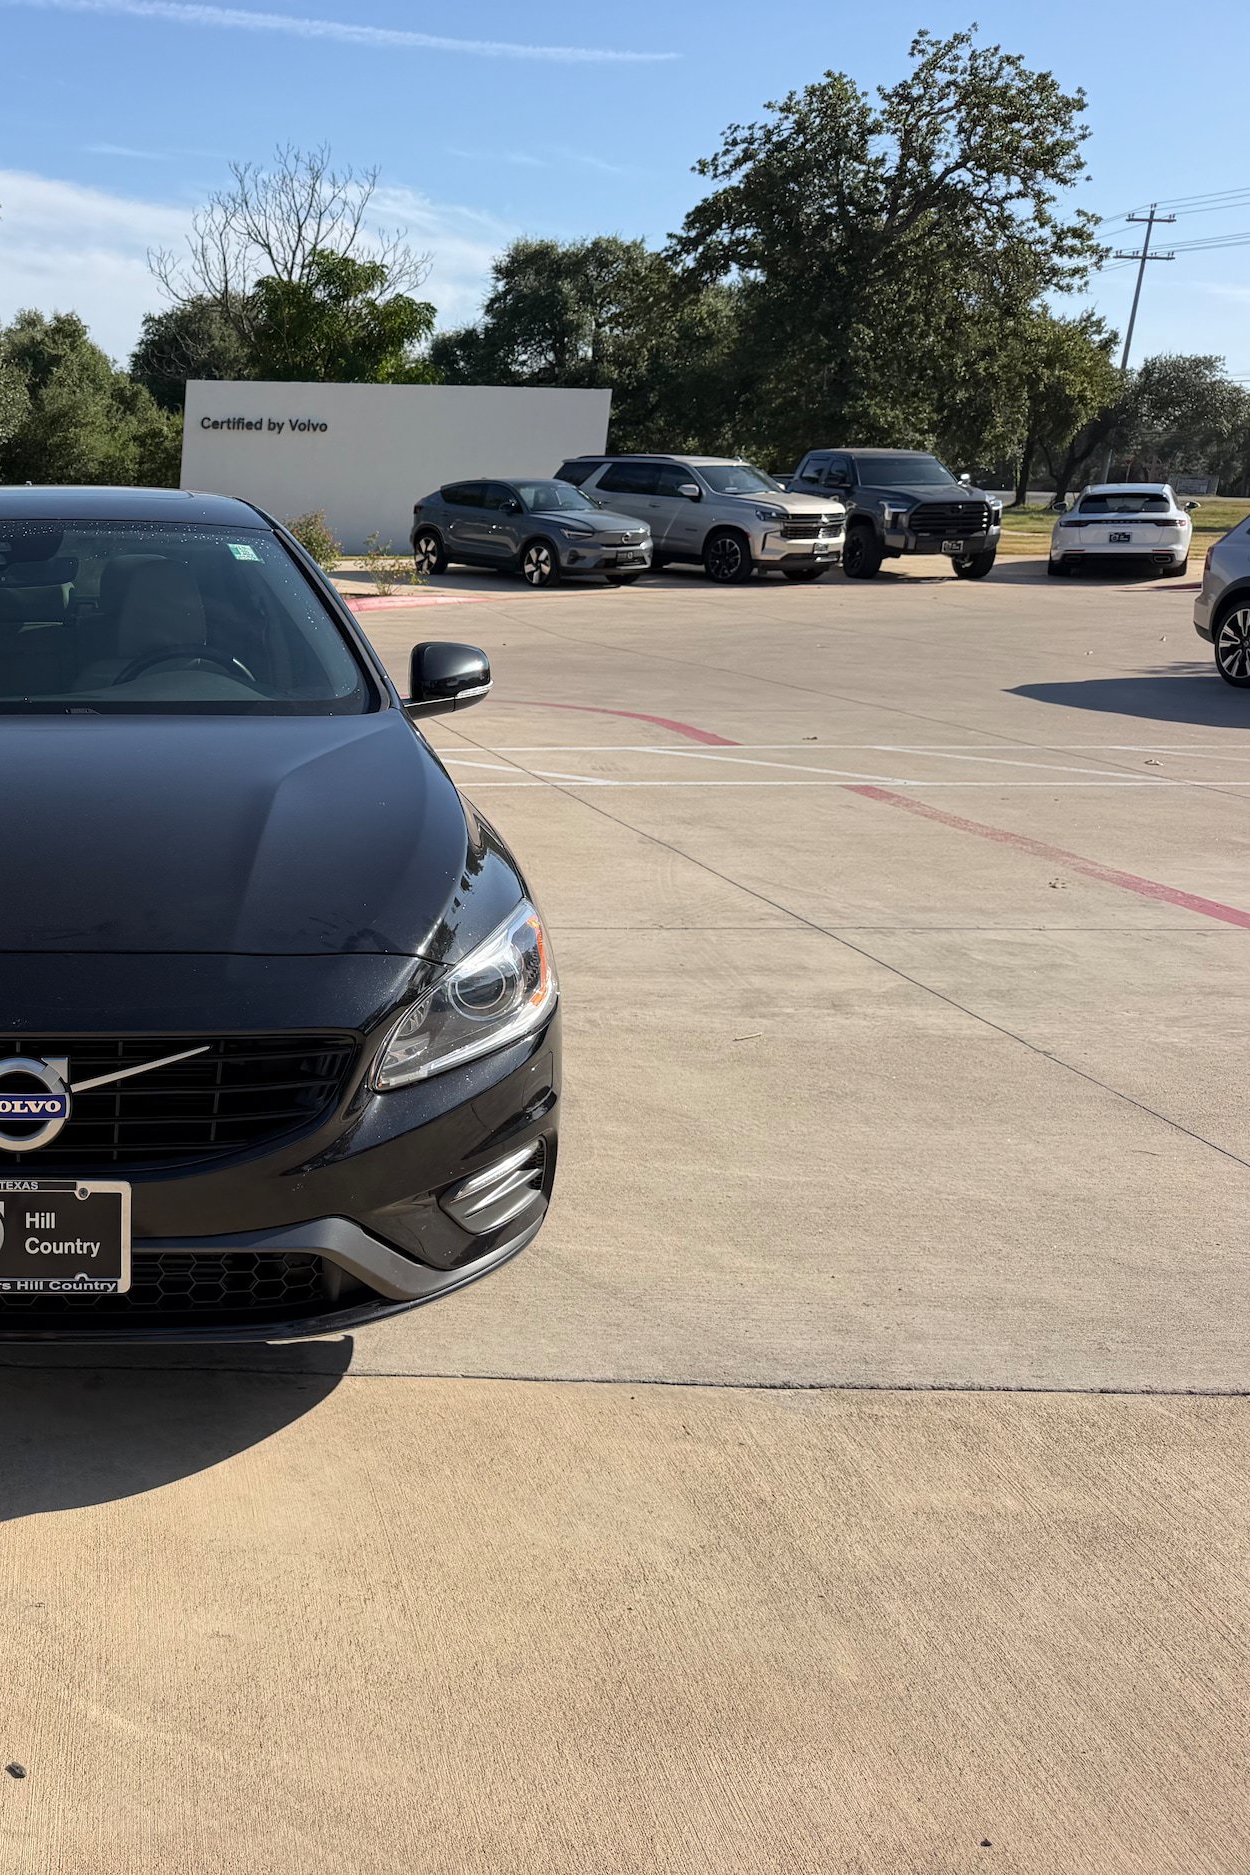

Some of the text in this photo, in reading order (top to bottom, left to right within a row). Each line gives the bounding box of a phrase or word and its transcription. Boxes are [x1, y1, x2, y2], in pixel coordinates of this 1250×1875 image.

[200, 417, 328, 435] Certified by Volvo
[25, 1212, 56, 1229] Hill
[24, 1236, 101, 1258] Country
[16, 1281, 44, 1291] Hill
[48, 1281, 117, 1293] Country
